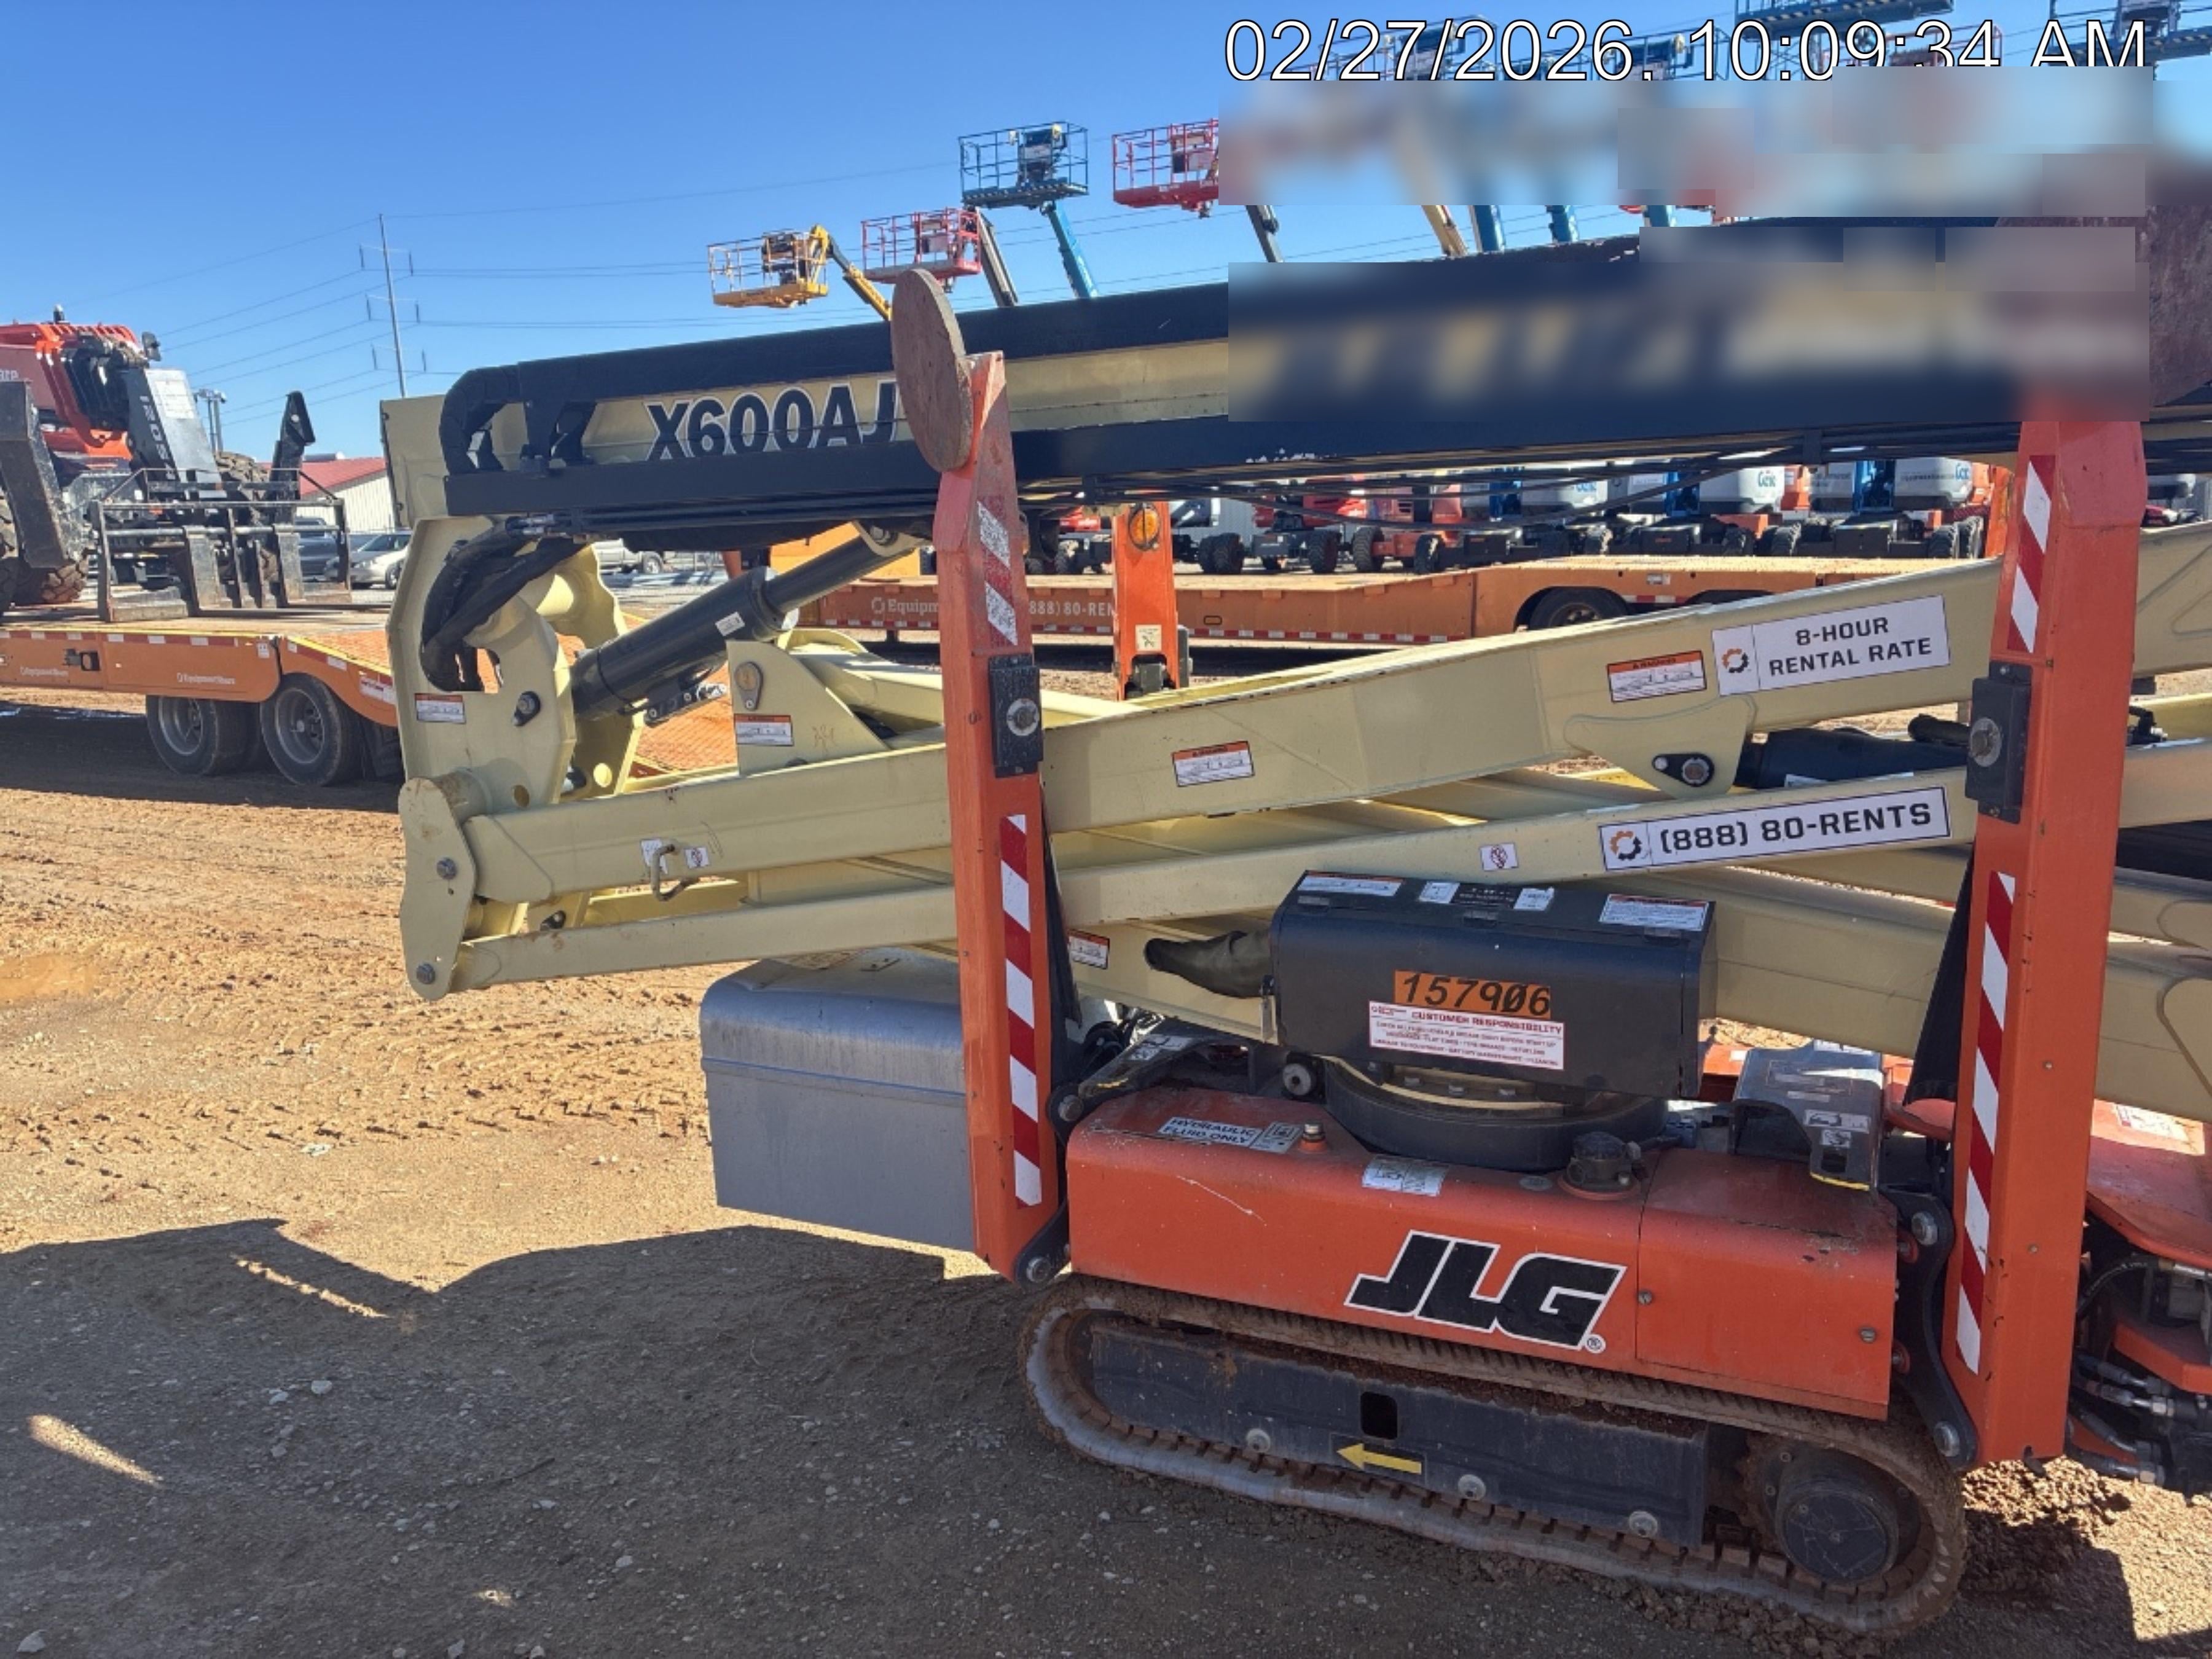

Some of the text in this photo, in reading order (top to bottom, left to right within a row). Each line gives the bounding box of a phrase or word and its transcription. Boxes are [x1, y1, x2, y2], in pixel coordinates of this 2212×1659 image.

[644, 379, 900, 461] X600AJ
[1029, 600, 1061, 616] 888)
[1063, 602, 1115, 616] 80-REN
[1795, 616, 1889, 646] 8-HOUR
[1769, 637, 1932, 677] RENTAL RATE
[1660, 802, 1931, 853] (888) 80-RENTS
[1403, 973, 1550, 1016] 157906
[1411, 1011, 1470, 1024] CUSTOMER
[1472, 1017, 1562, 1034] RESPONSIBILITY
[1163, 1126, 1250, 1144] FLUID ONLY
[1170, 1118, 1256, 1136] HYDRAULIC
[1344, 1230, 1628, 1351] JLG
